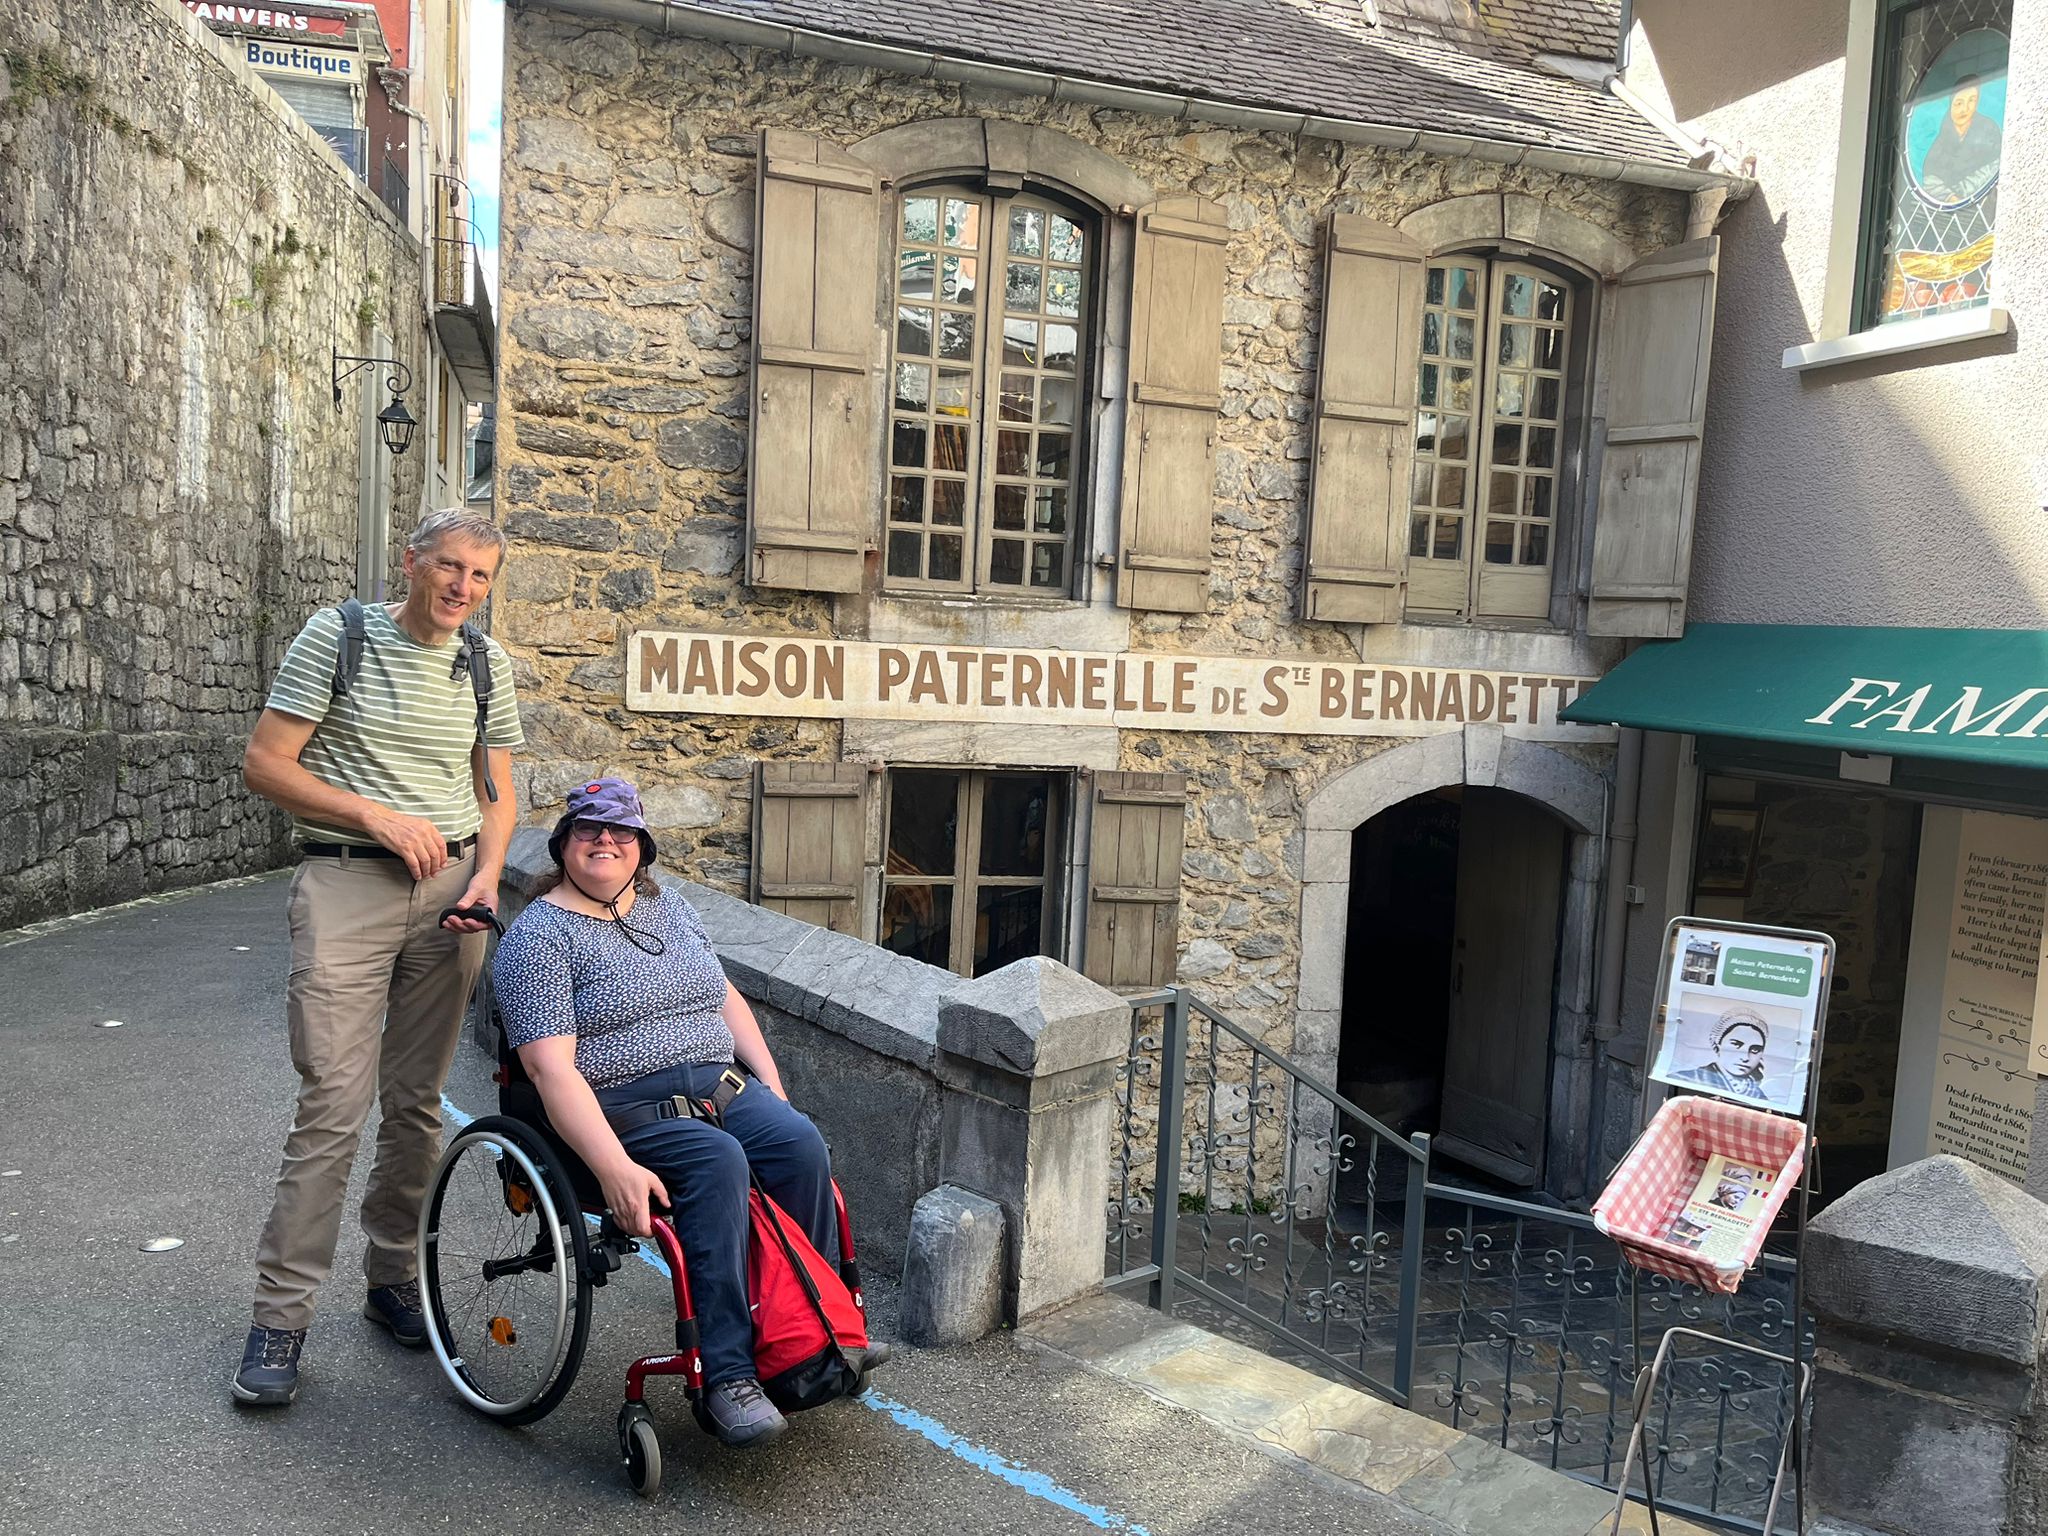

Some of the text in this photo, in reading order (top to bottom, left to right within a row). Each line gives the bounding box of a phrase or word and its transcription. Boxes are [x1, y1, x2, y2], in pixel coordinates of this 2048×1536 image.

[186, 1, 308, 30] ANVER'S
[247, 42, 351, 75] Boutique
[640, 637, 844, 701] MAISON
[878, 648, 1197, 713] PATERNELLE
[1212, 686, 1247, 715] DE
[1804, 677, 2048, 738] FAMI
[1966, 864, 1984, 877] july
[1968, 852, 1991, 863] From
[1992, 856, 2031, 873] february
[1964, 877, 2043, 899] often came here to
[1964, 889, 1978, 899] her
[2011, 898, 2026, 908] her
[1967, 916, 1988, 928] Here
[1990, 920, 1997, 929] is
[1998, 922, 2012, 933] the
[2014, 924, 2031, 936] bed
[1977, 907, 1994, 918] very
[1996, 908, 2006, 918] ill
[2019, 913, 2035, 924] this
[1958, 926, 2038, 952] Bernadette slept in
[1970, 942, 1982, 952] all
[1984, 945, 1998, 956] the
[1730, 958, 1755, 967] Maison
[1757, 960, 1794, 972] Paternelle
[1951, 950, 1993, 970] belonging
[1994, 962, 2004, 970] to
[2006, 962, 2021, 974] her
[1732, 968, 1800, 984] Sainte Bernadette
[1945, 1084, 1970, 1098] Desde
[1970, 1092, 2002, 1110] febrero
[2002, 1103, 2014, 1114] de
[1948, 1096, 2028, 1133] hasta julio de 1866,
[1936, 1120, 1970, 1137] menudo
[1977, 1136, 1994, 1147] esta
[1996, 1142, 2014, 1154] casa
[1948, 1110, 1998, 1135] Bernarditta
[2000, 1130, 2018, 1142] vino
[1934, 1132, 1948, 1141] ver
[1954, 1140, 1964, 1148] su
[1710, 1212, 1750, 1228] BERNADETTE
